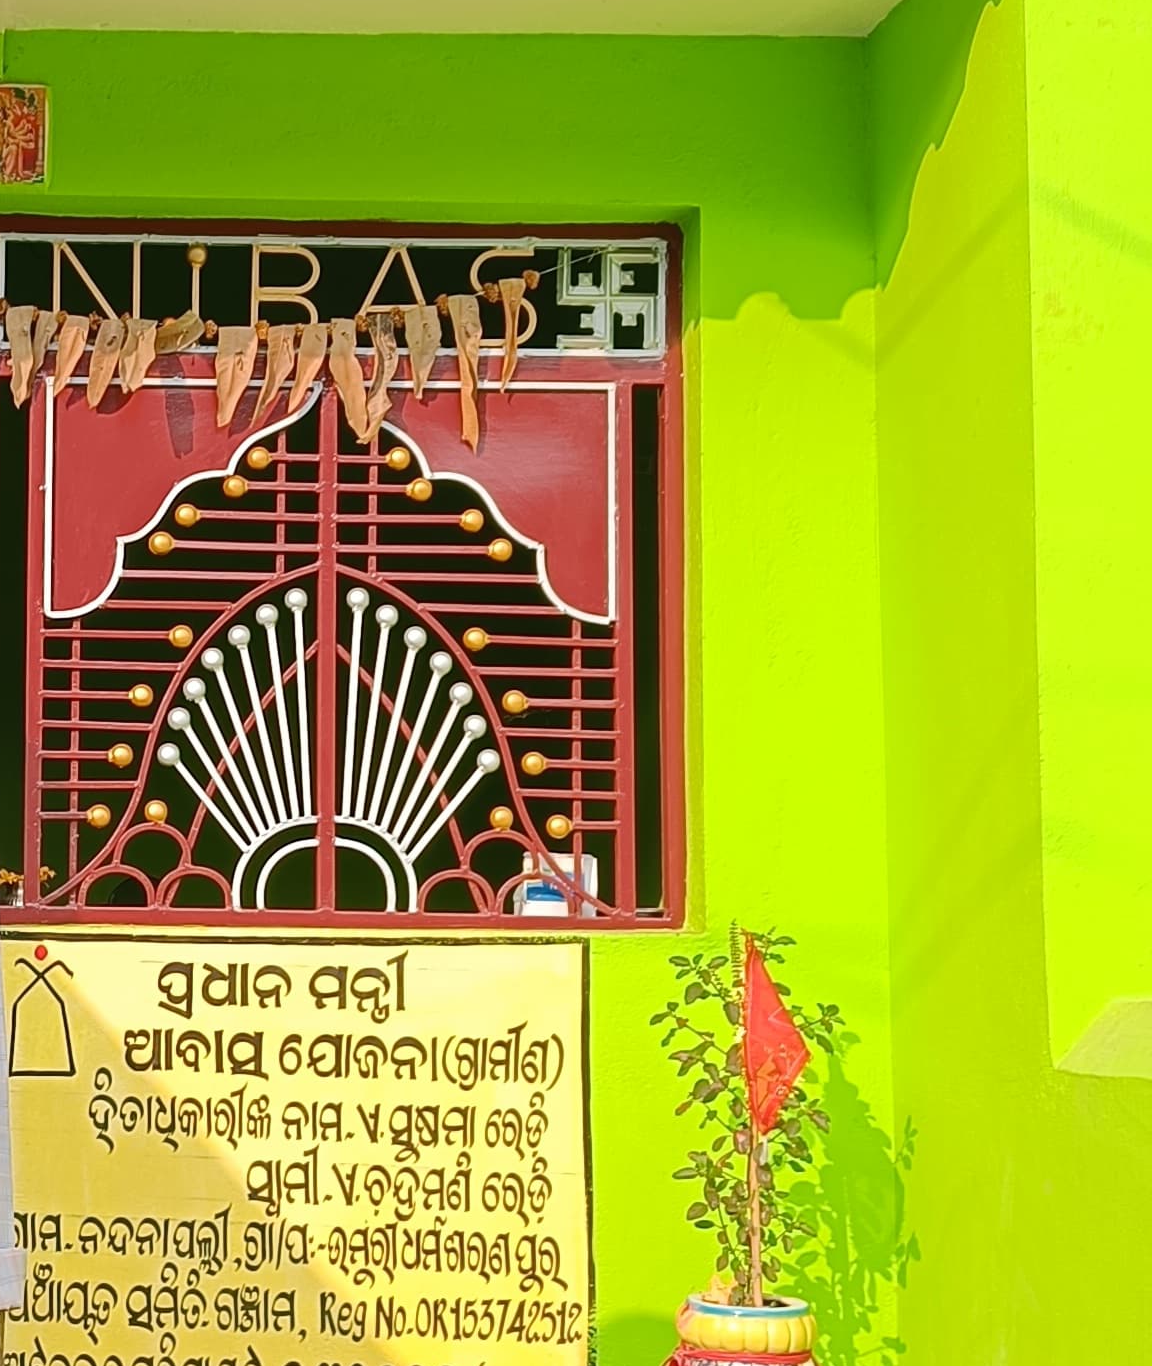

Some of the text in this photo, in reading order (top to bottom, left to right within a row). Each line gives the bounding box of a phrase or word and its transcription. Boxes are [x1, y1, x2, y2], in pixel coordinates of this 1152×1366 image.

[157, 961, 292, 1020] ପ୍ରଧାନ
[123, 1027, 270, 1081] ଆବାସ
[319, 1290, 367, 1342] Reg
